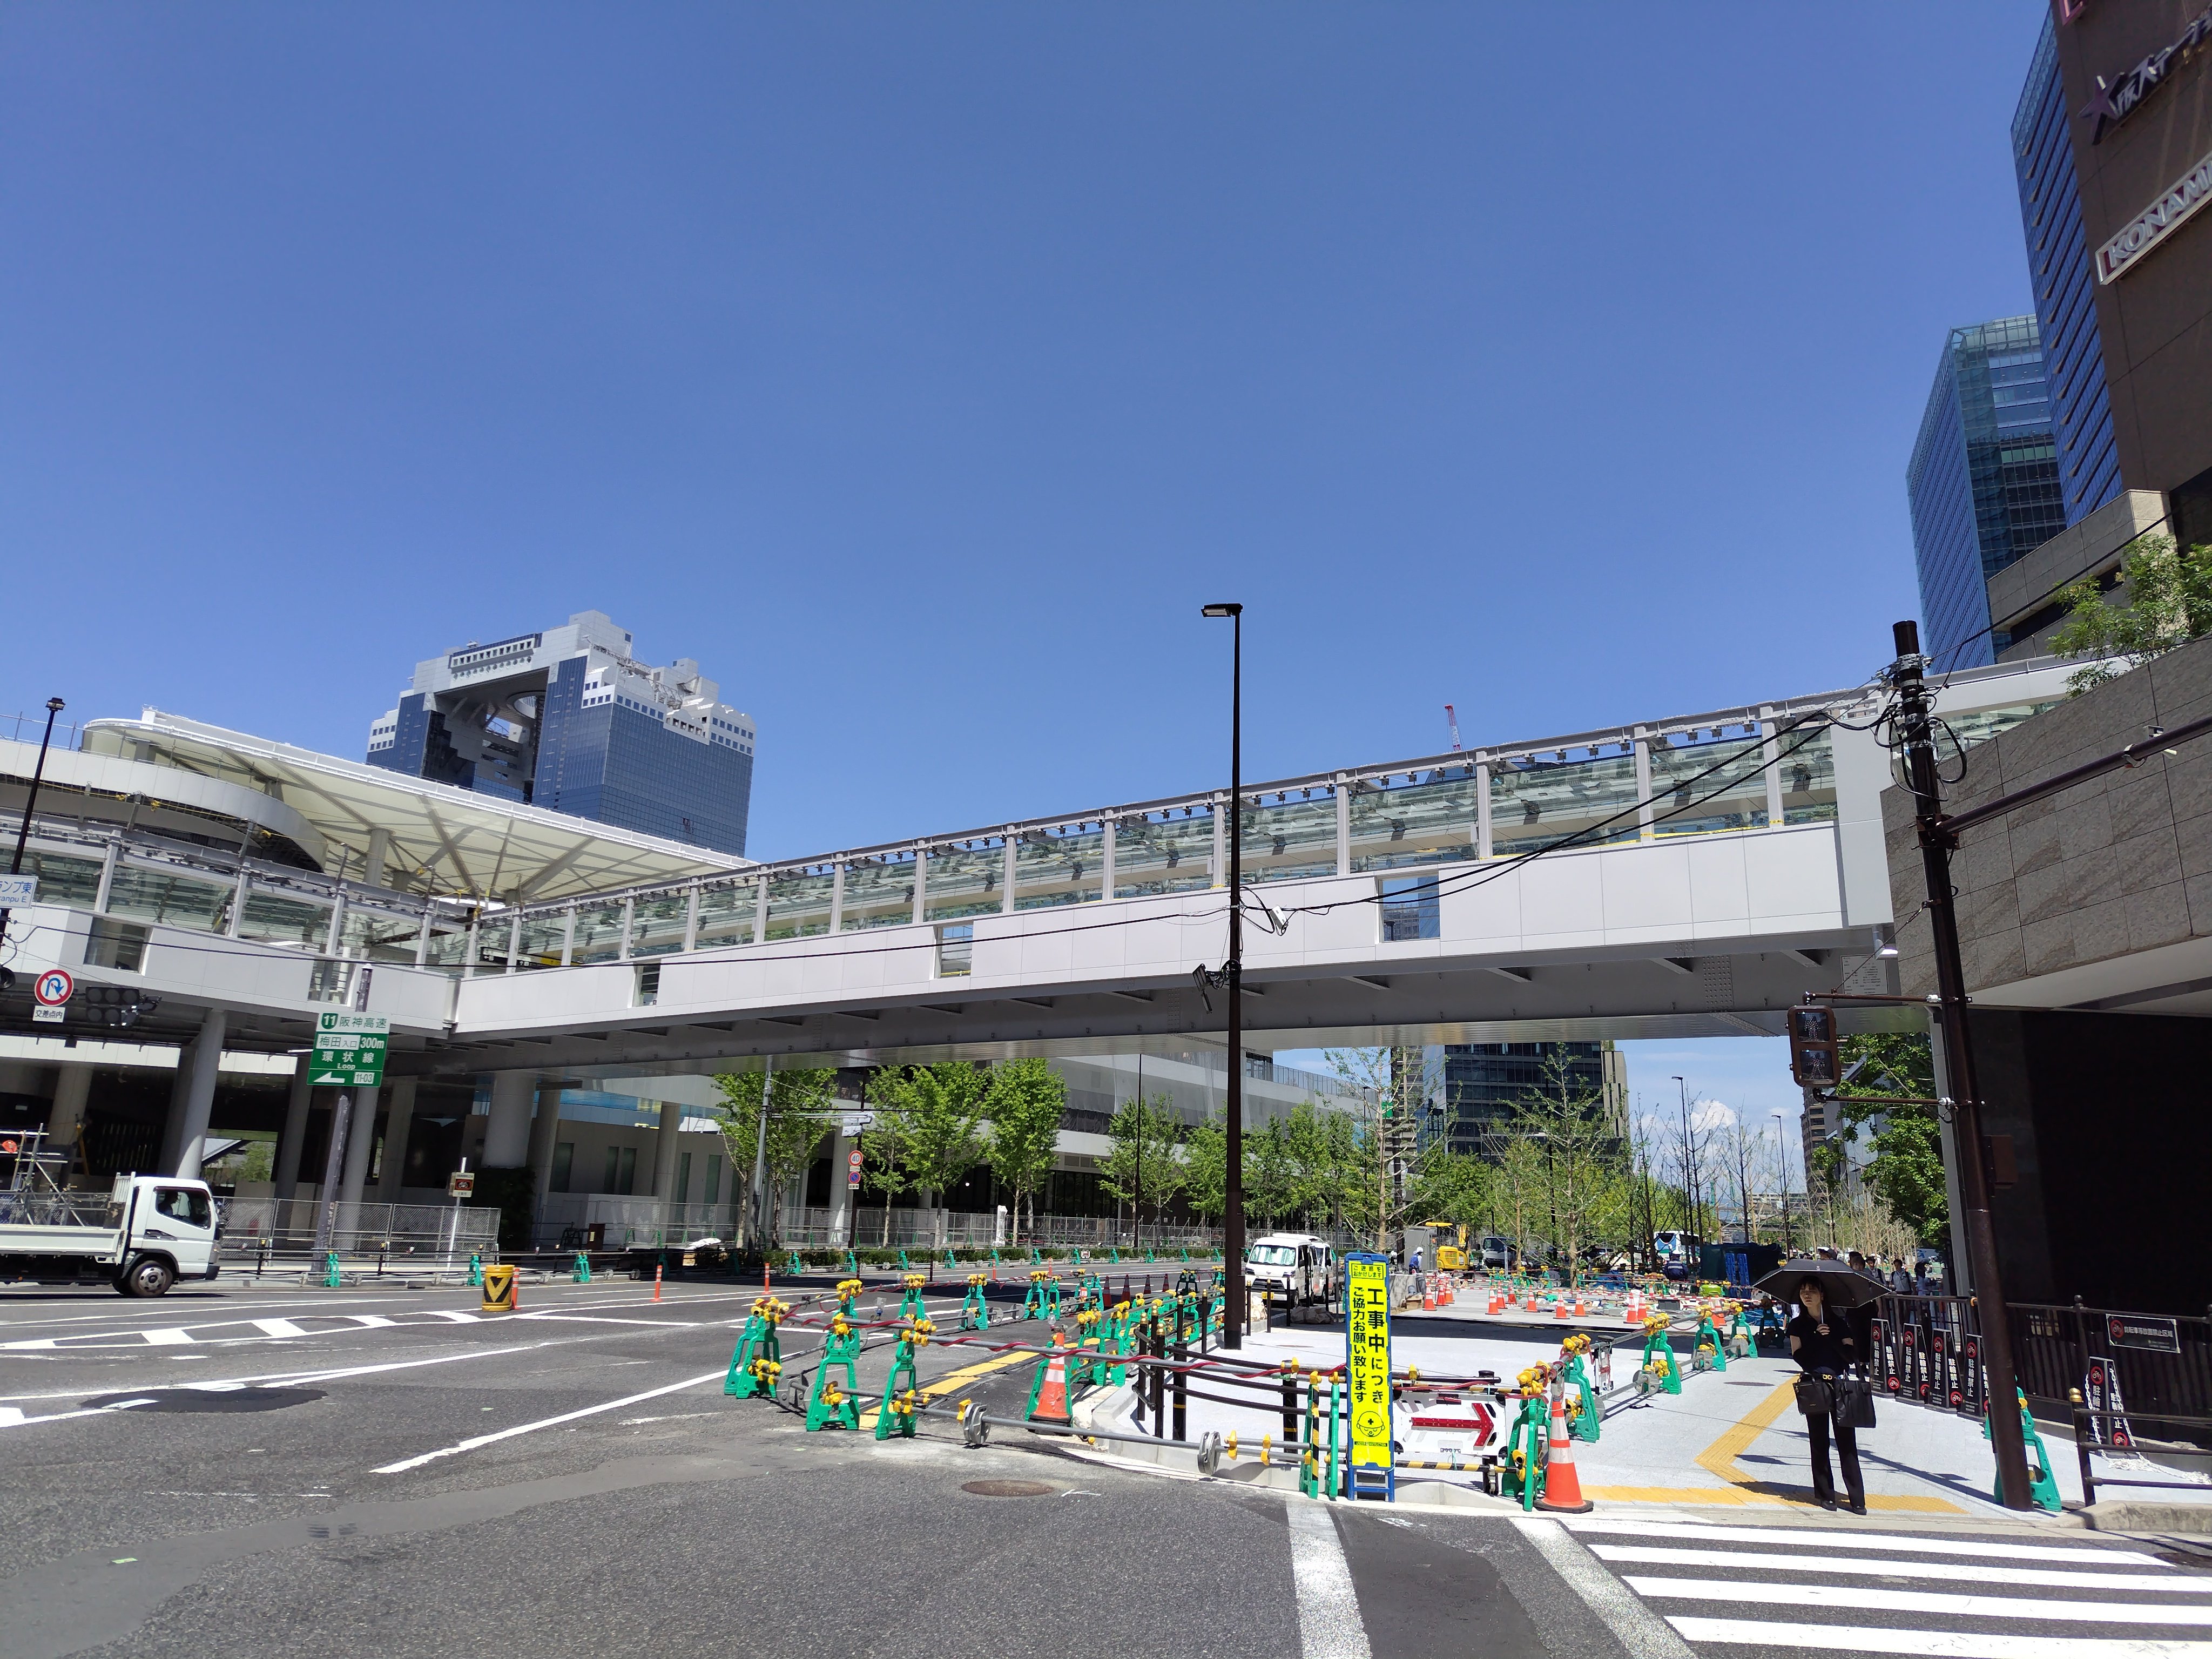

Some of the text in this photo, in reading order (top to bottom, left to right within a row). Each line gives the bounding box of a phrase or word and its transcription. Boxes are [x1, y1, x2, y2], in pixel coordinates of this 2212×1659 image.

[0, 881, 32, 894] ンプ東
[35, 1009, 63, 1019] 交差点内
[323, 1015, 387, 1029] 11 阪神高速
[360, 1037, 385, 1049] 300m
[322, 1051, 374, 1063] 環状線
[356, 1074, 373, 1083] 11-03
[1353, 1286, 1367, 1403] ご協力お願い致します
[1367, 1288, 1385, 1404] 工事中につき
